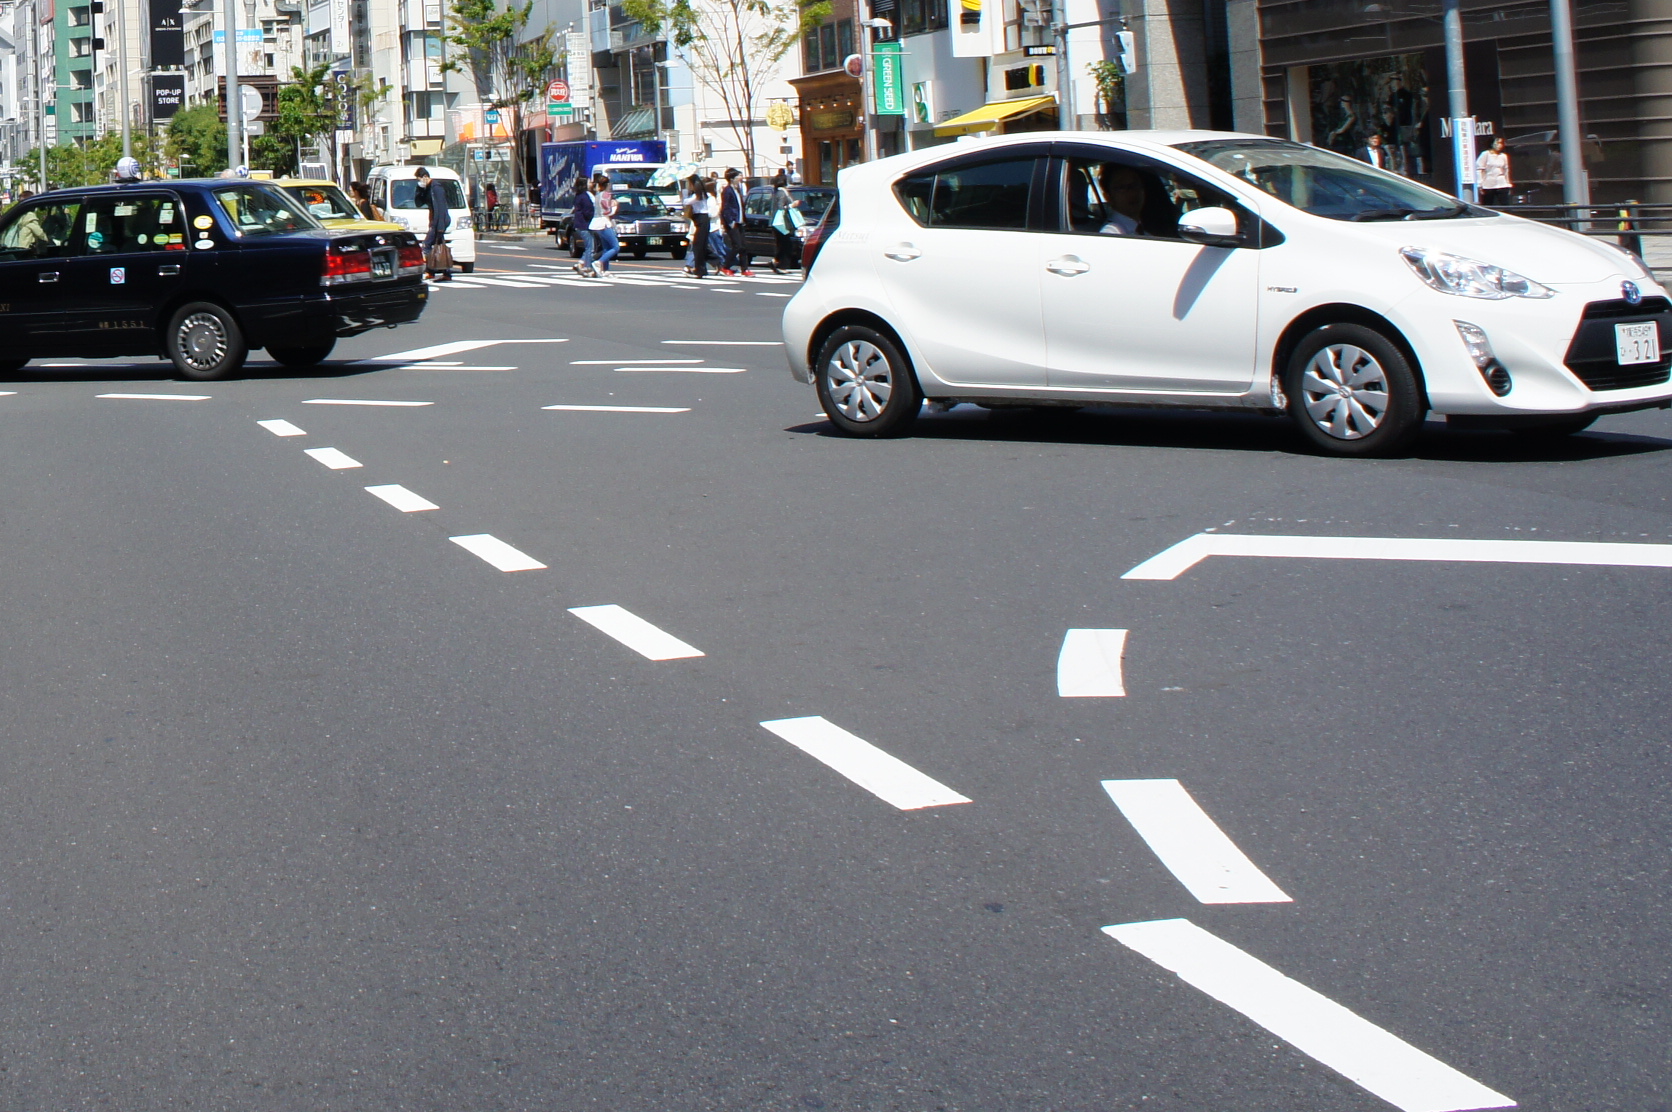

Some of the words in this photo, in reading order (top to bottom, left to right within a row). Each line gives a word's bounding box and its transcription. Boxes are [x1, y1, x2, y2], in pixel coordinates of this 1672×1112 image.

[882, 57, 893, 87] GREEN
[155, 88, 182, 96] POP-UP
[883, 87, 894, 110] SEED
[158, 97, 180, 105] STORE
[1440, 115, 1494, 139] Mara
[114, 320, 145, 329] 1551
